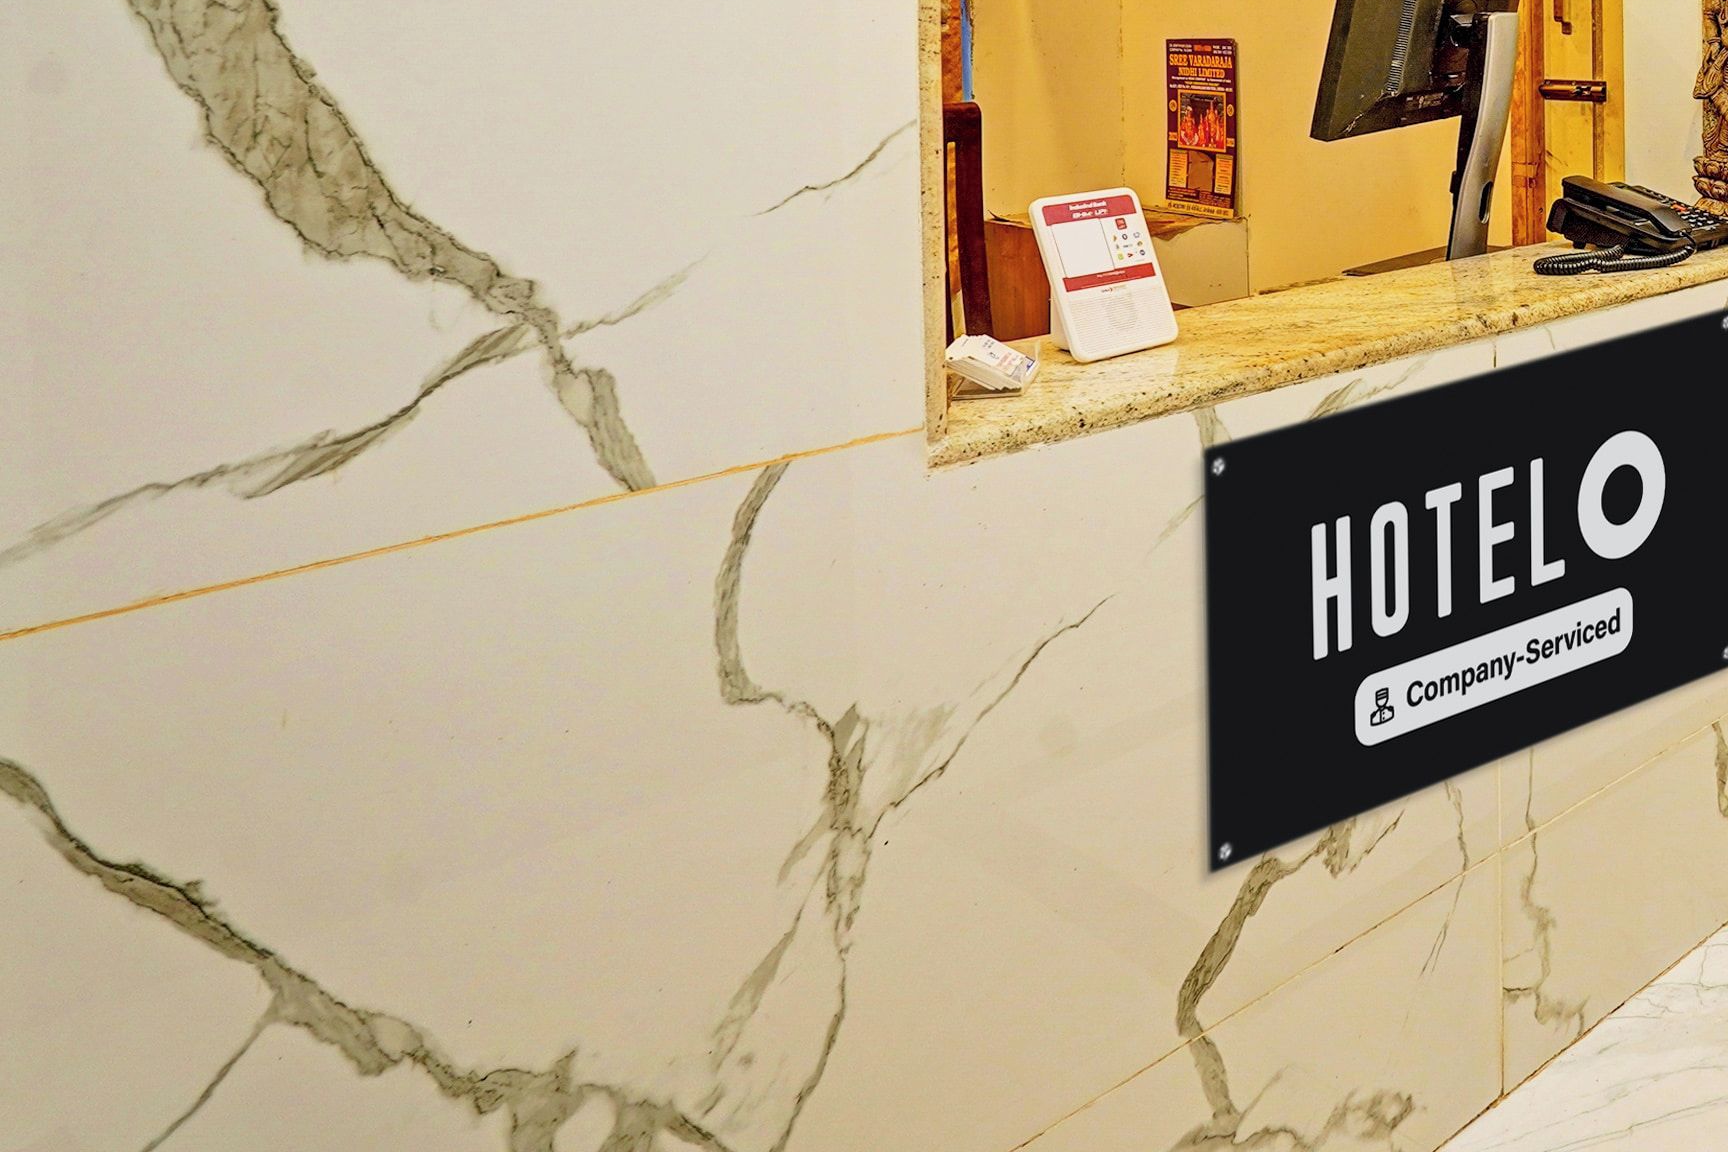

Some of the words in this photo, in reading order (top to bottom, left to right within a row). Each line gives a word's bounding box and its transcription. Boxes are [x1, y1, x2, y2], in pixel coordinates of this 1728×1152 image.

[1169, 53, 1188, 66] SREE
[1189, 54, 1233, 68] VARADARAJA
[1198, 67, 1226, 79] LIMITED
[1311, 457, 1566, 661] HOTEL
[1577, 430, 1666, 559] O
[1406, 607, 1621, 708] Company-Serviced
